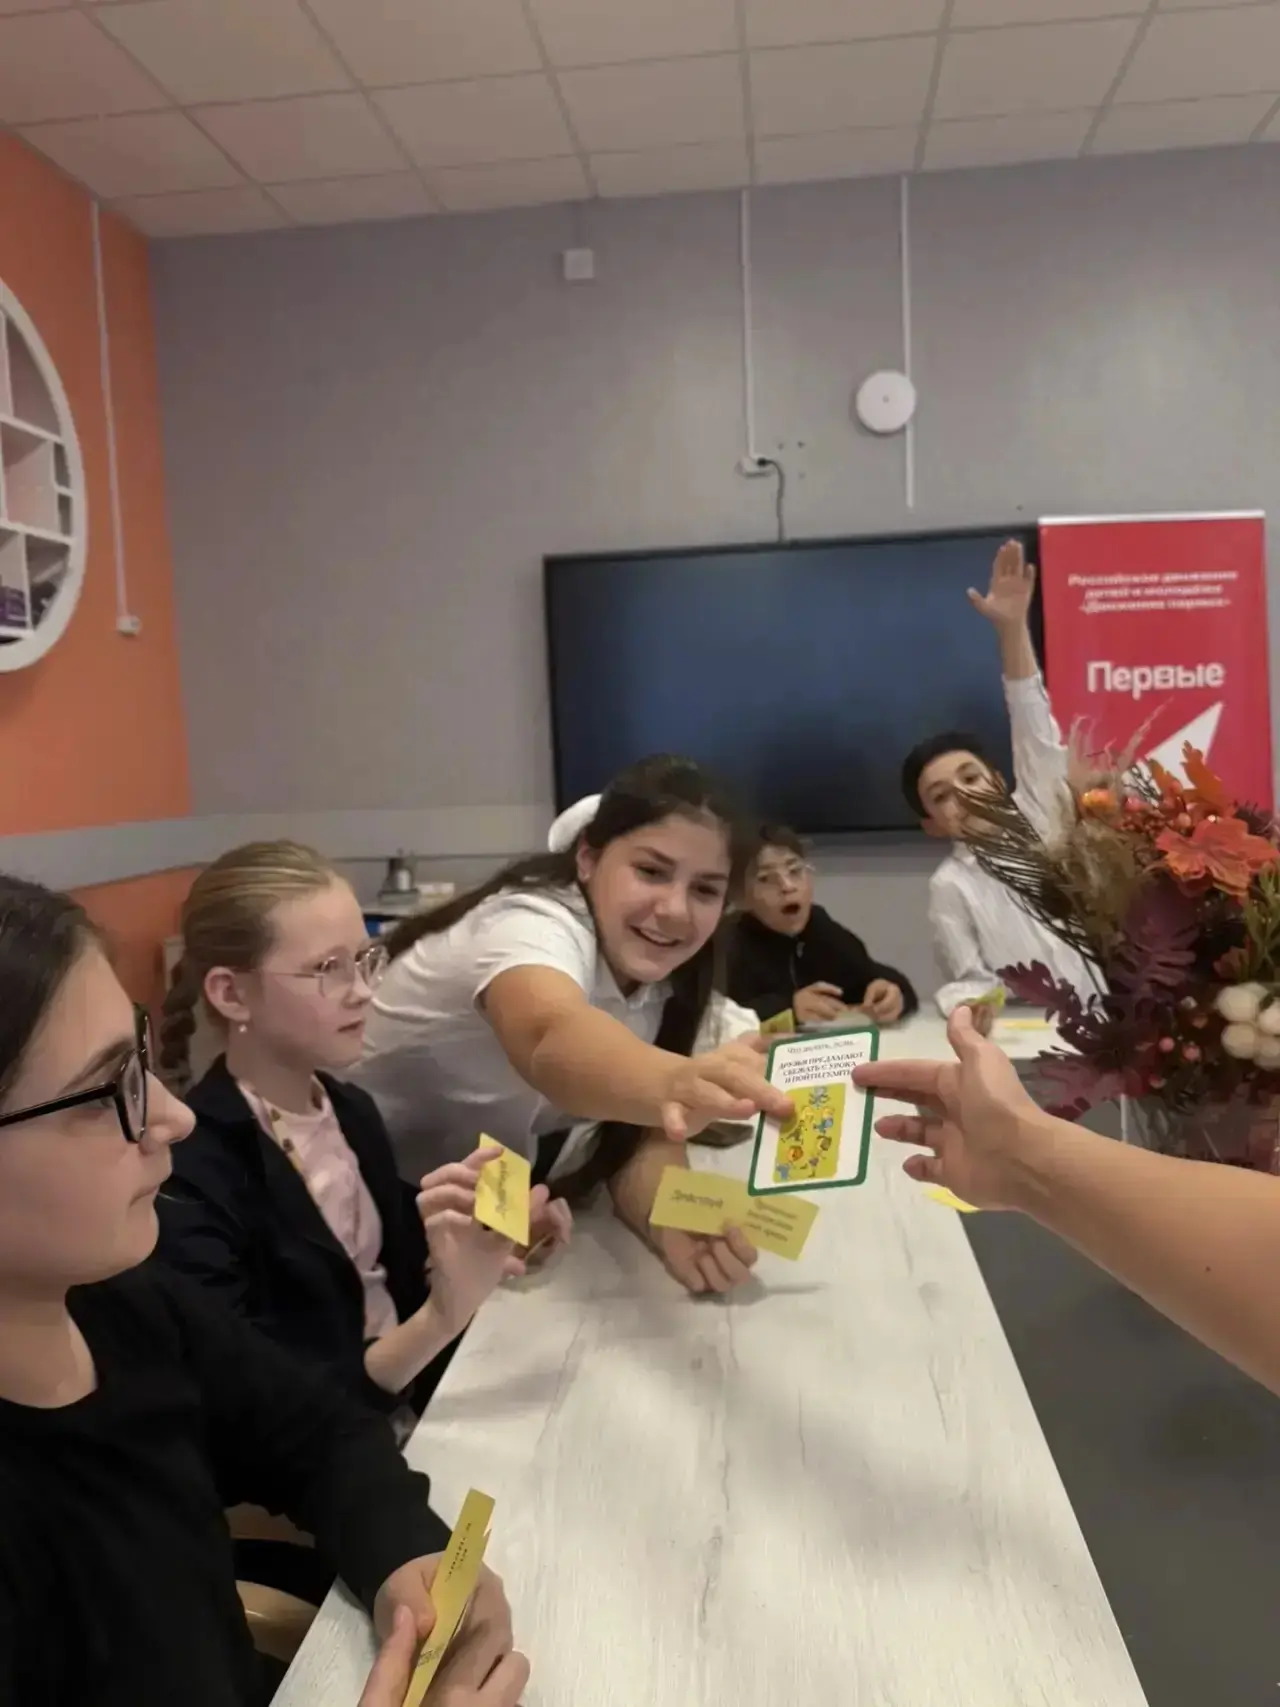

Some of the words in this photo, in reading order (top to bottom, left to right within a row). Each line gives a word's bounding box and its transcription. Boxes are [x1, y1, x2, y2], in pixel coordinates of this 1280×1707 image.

[1087, 661, 1226, 700] Первые
[780, 1059, 807, 1070] ДРУЗЬЯ
[807, 1052, 864, 1065] ПРЕДЛАГАЮТ
[783, 1064, 820, 1076] СБЕЖАТЬ
[829, 1061, 857, 1070] УРОКА
